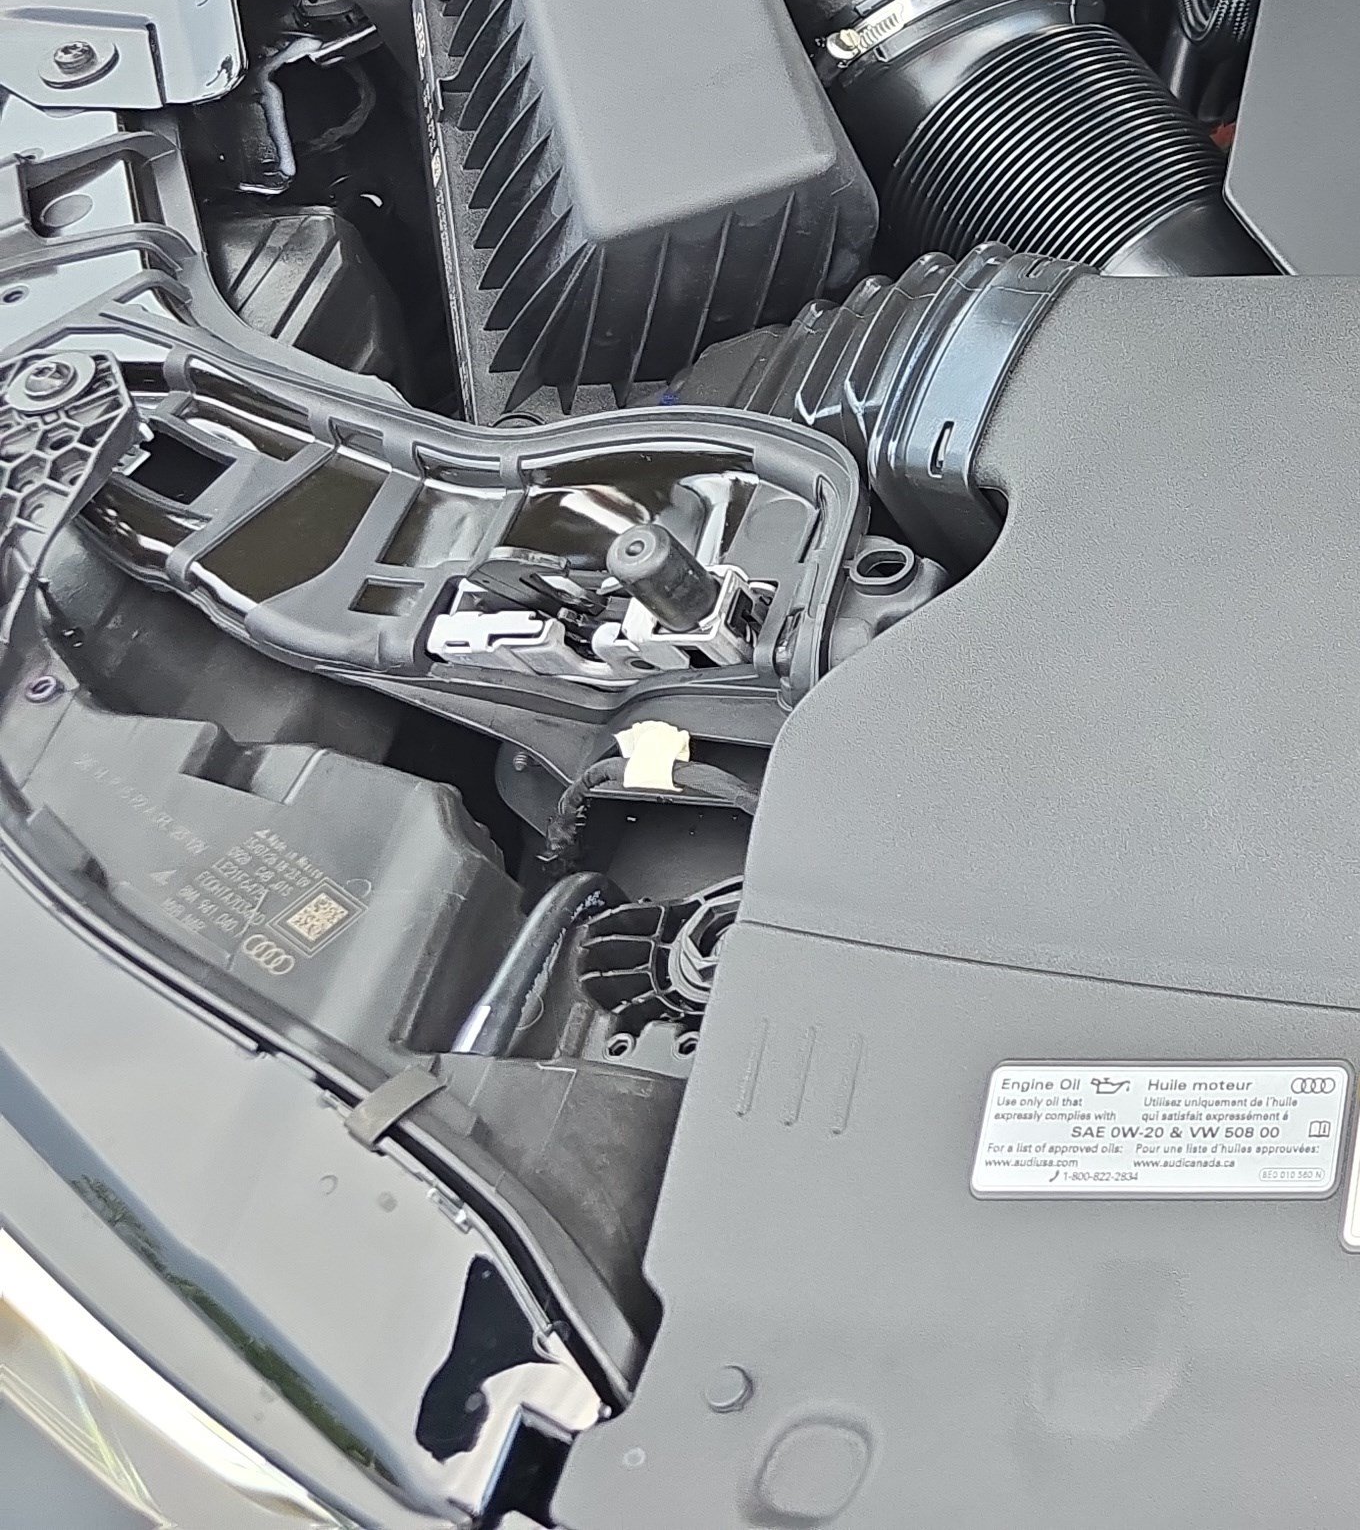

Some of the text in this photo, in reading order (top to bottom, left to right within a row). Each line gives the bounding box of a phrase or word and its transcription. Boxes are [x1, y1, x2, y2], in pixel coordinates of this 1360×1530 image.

[1001, 1078, 1081, 1092] Engine Oil
[1147, 1079, 1253, 1091] Huile moteur
[996, 1096, 1083, 1108] Use only oil that
[1143, 1097, 1182, 1107] Utilisez
[1184, 1097, 1247, 1109] uniquement
[1250, 1097, 1263, 1107] de
[994, 1111, 1117, 1122] expressly complies with
[1141, 1111, 1159, 1123] qui
[1161, 1111, 1203, 1121] satisfait
[1205, 1111, 1280, 1123] expressément
[1071, 1126, 1280, 1138] SAE 0W-20 & VW 508 00
[987, 1143, 1123, 1155] For a list of approved oils:
[1136, 1143, 1159, 1153] Pour
[1163, 1145, 1183, 1153] une
[1186, 1144, 1208, 1153] liste
[1255, 1144, 1320, 1155] approuvées:
[985, 1158, 1078, 1168] www.audiusa.com
[1133, 1158, 1235, 1168] www.audicanada.ca
